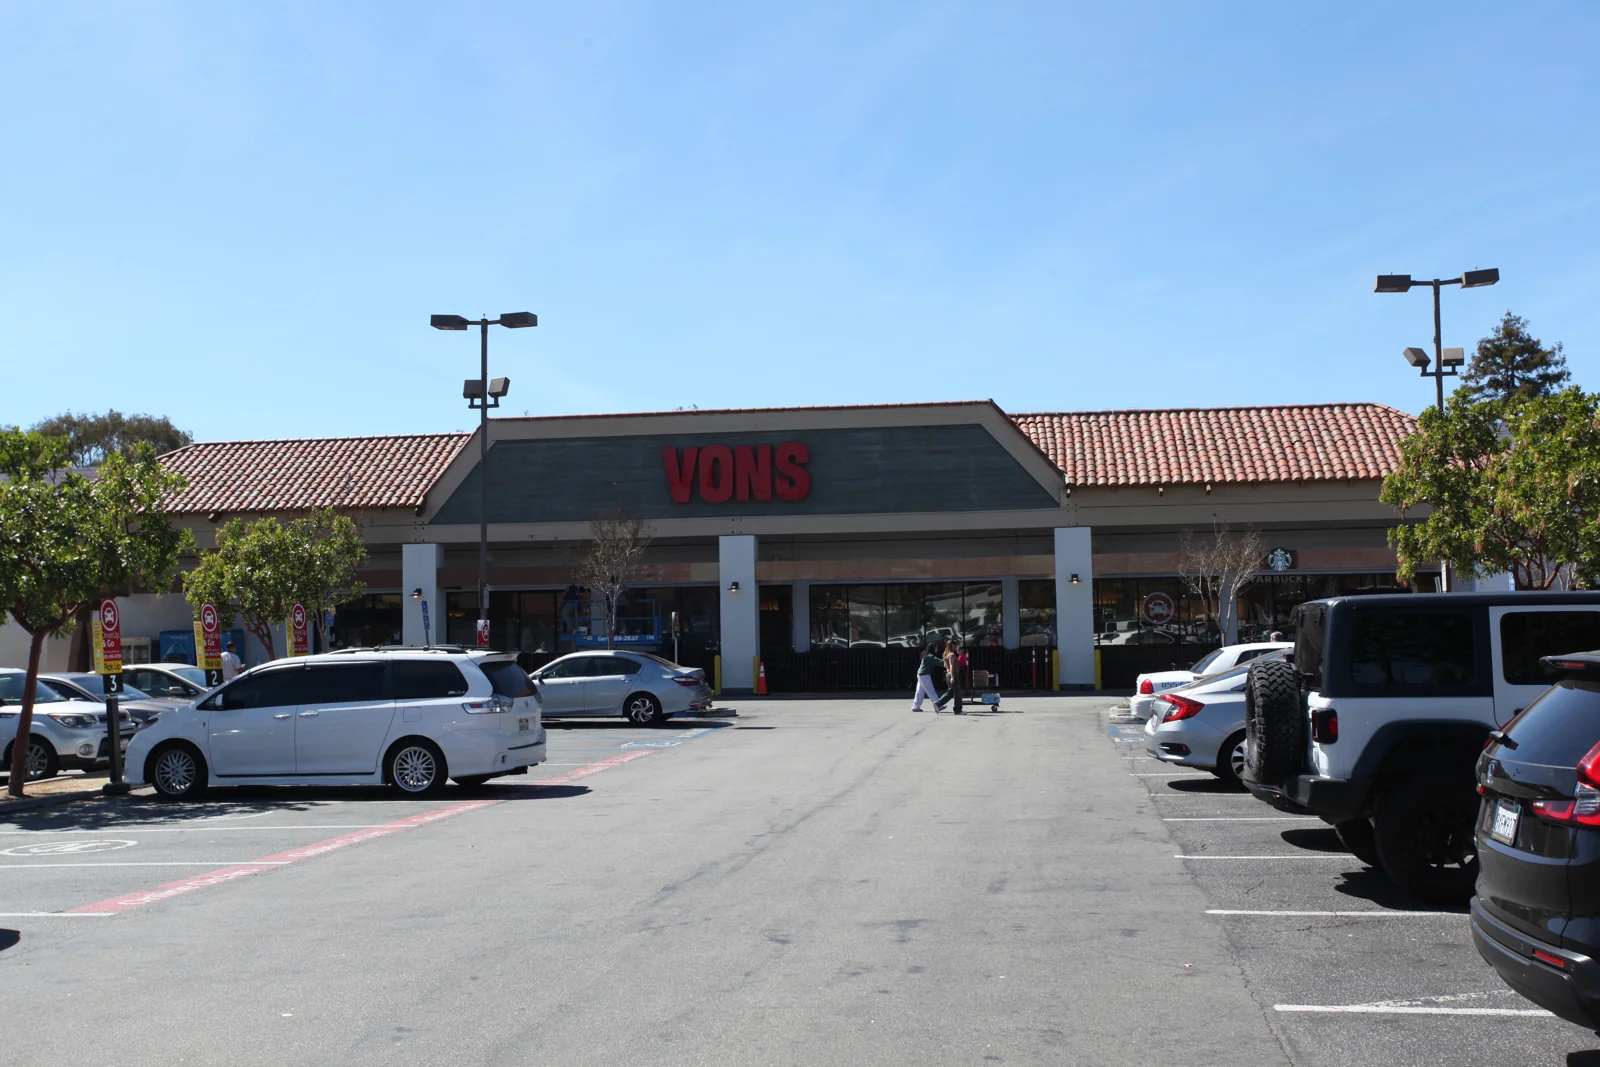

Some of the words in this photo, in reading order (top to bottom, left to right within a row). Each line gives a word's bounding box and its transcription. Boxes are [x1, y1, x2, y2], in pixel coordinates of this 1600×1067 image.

[662, 440, 811, 504] VONS
[104, 663, 113, 671] Pick
[113, 663, 121, 671] Up
[109, 674, 118, 692] 3
[211, 670, 218, 686] 2
